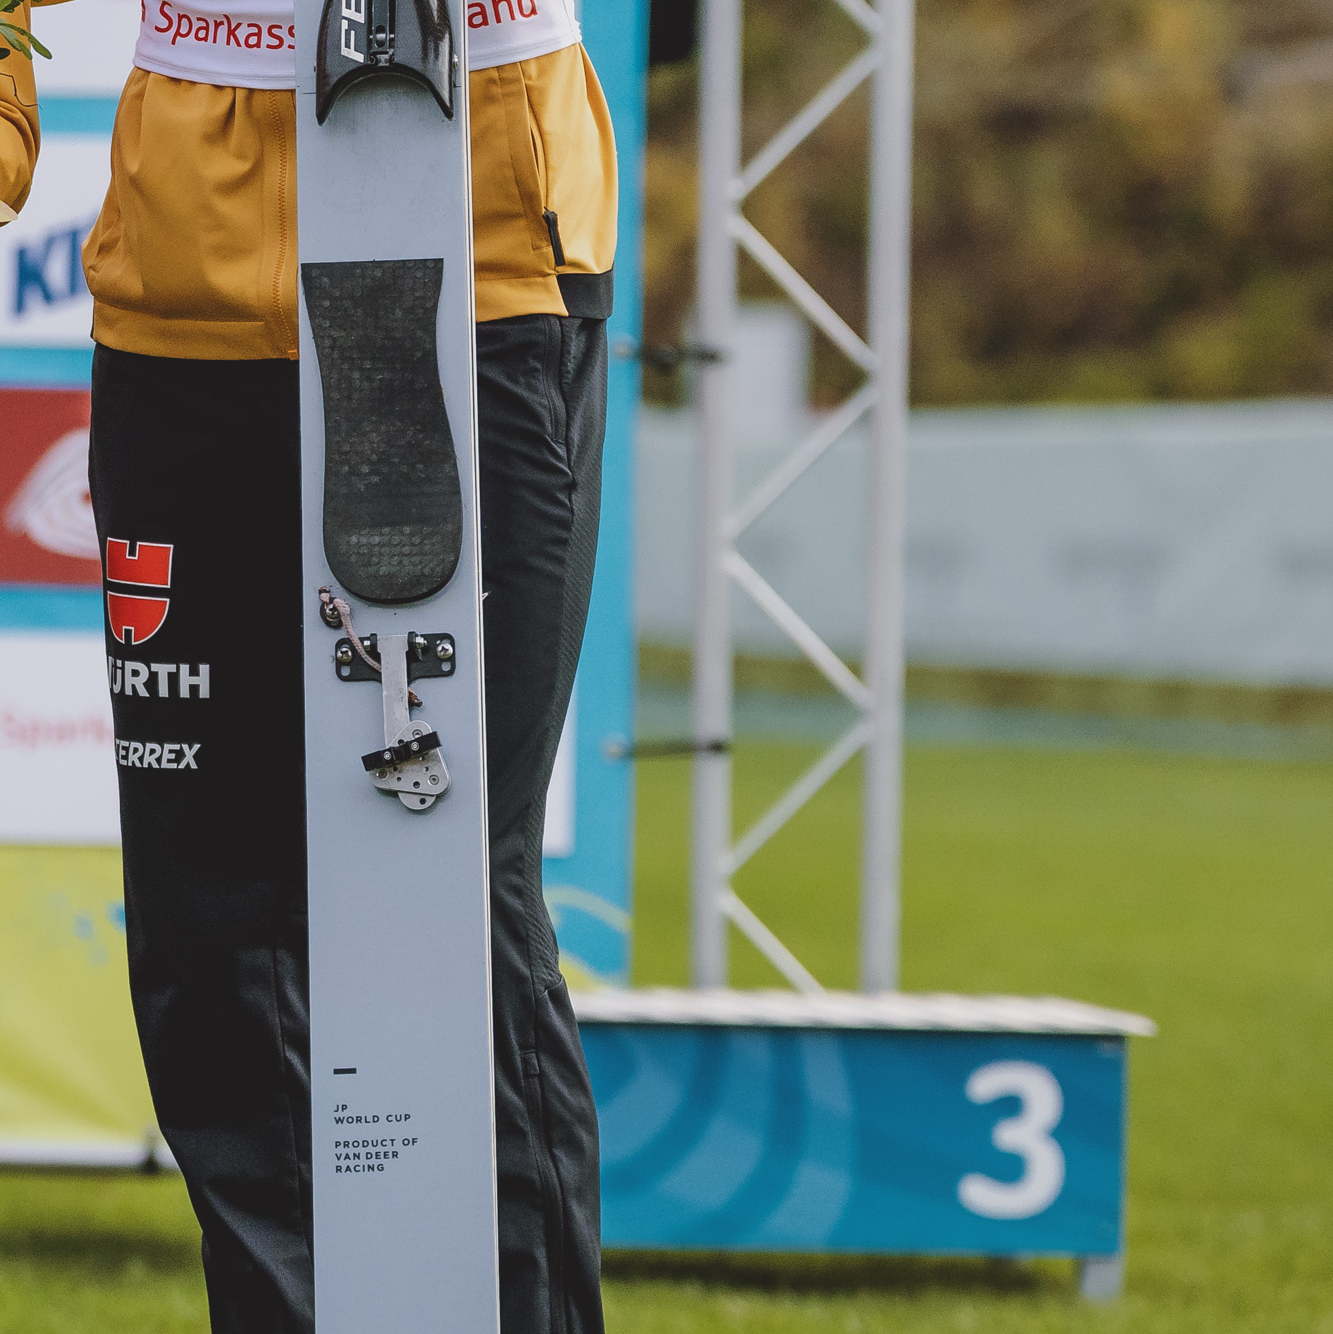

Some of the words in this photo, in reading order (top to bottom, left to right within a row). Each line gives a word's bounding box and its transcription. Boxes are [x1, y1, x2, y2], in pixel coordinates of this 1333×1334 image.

[333, 1104, 349, 1113] JP
[333, 1114, 380, 1125] WORLD
[385, 1113, 412, 1123] CUP
[334, 1138, 396, 1149] PRODUCT
[401, 1137, 419, 1147] OF
[957, 1059, 1068, 1220] 3
[335, 1152, 361, 1162] VAN
[365, 1150, 400, 1161] DEER
[335, 1163, 385, 1174] RACING
